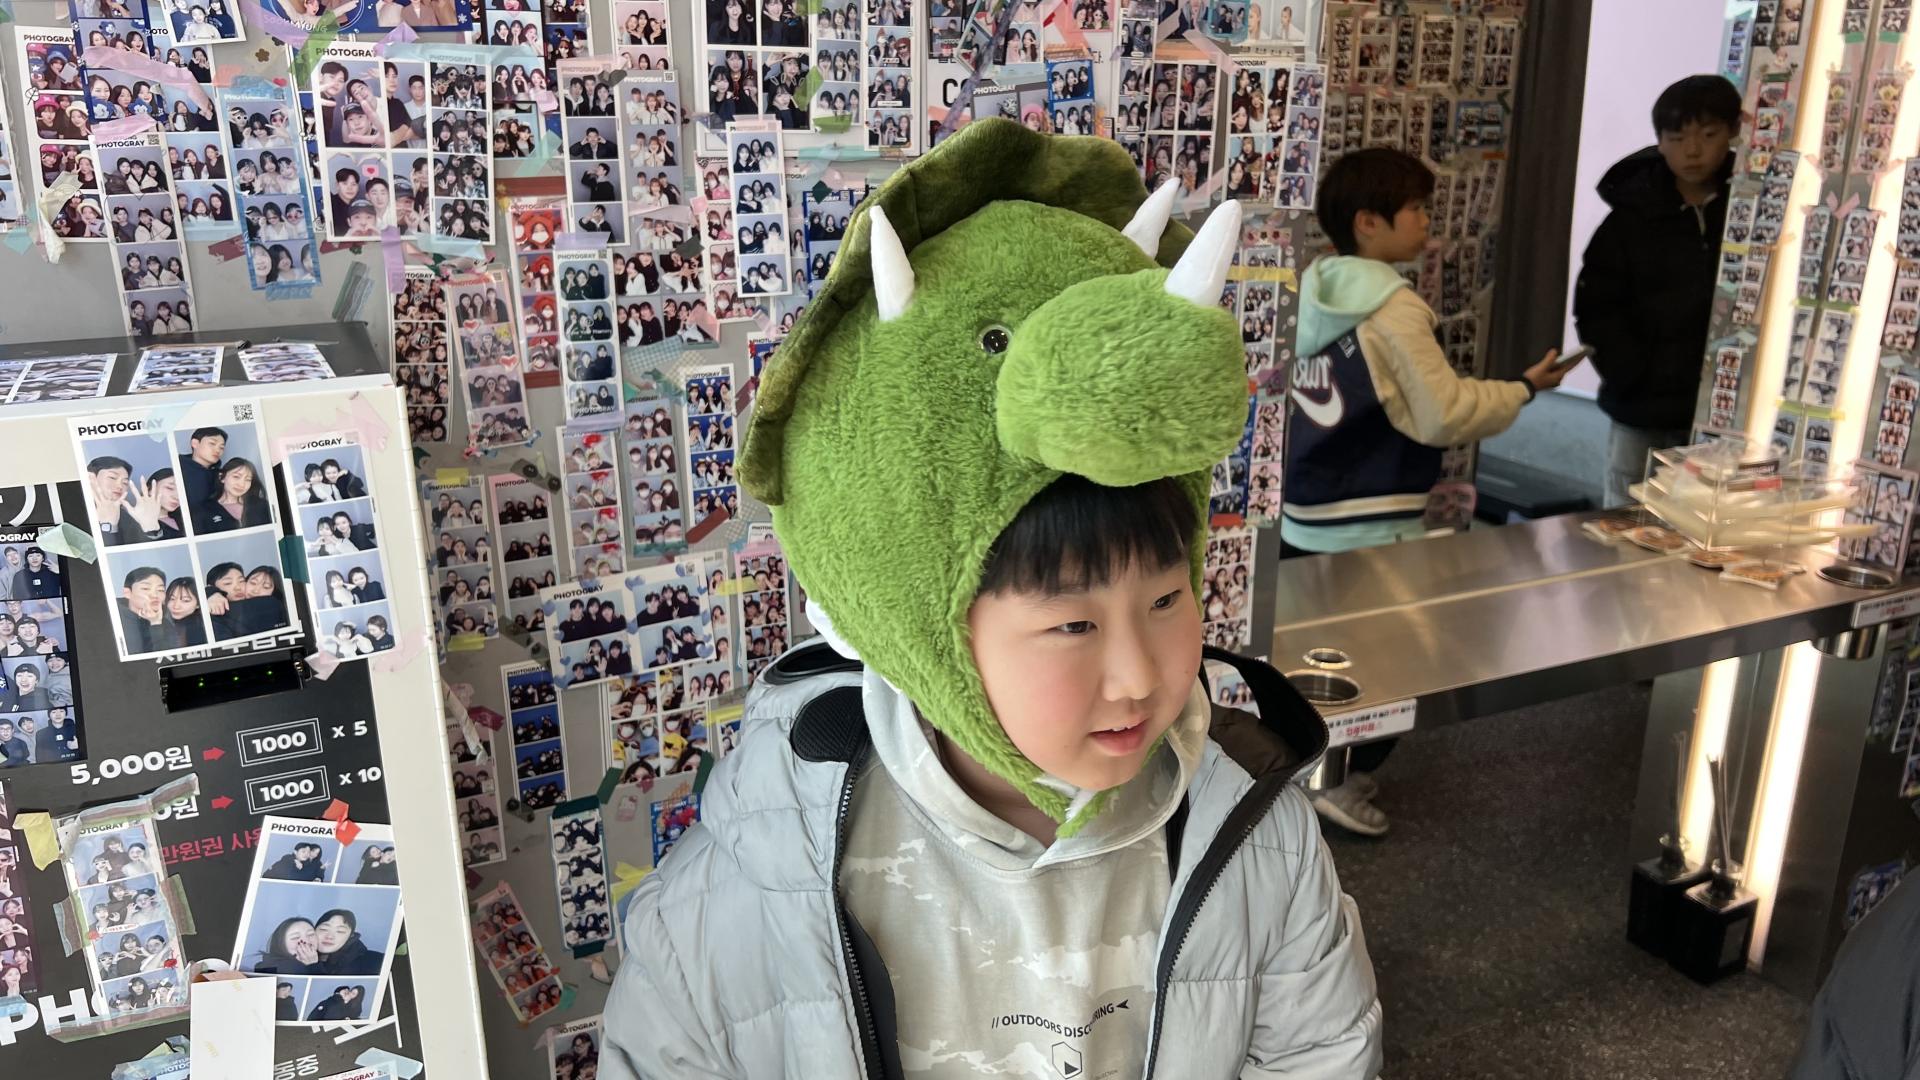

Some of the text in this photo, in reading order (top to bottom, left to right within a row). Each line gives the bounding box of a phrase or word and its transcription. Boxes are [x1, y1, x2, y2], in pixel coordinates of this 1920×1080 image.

[554, 585, 604, 600] PHOTOGRAY
[252, 731, 307, 754] 1000
[354, 720, 368, 736] 5
[71, 745, 193, 785] 5,000원
[260, 779, 315, 802] 1000
[357, 766, 382, 783] 10
[1002, 1014, 1062, 1035] OUTDOORS
